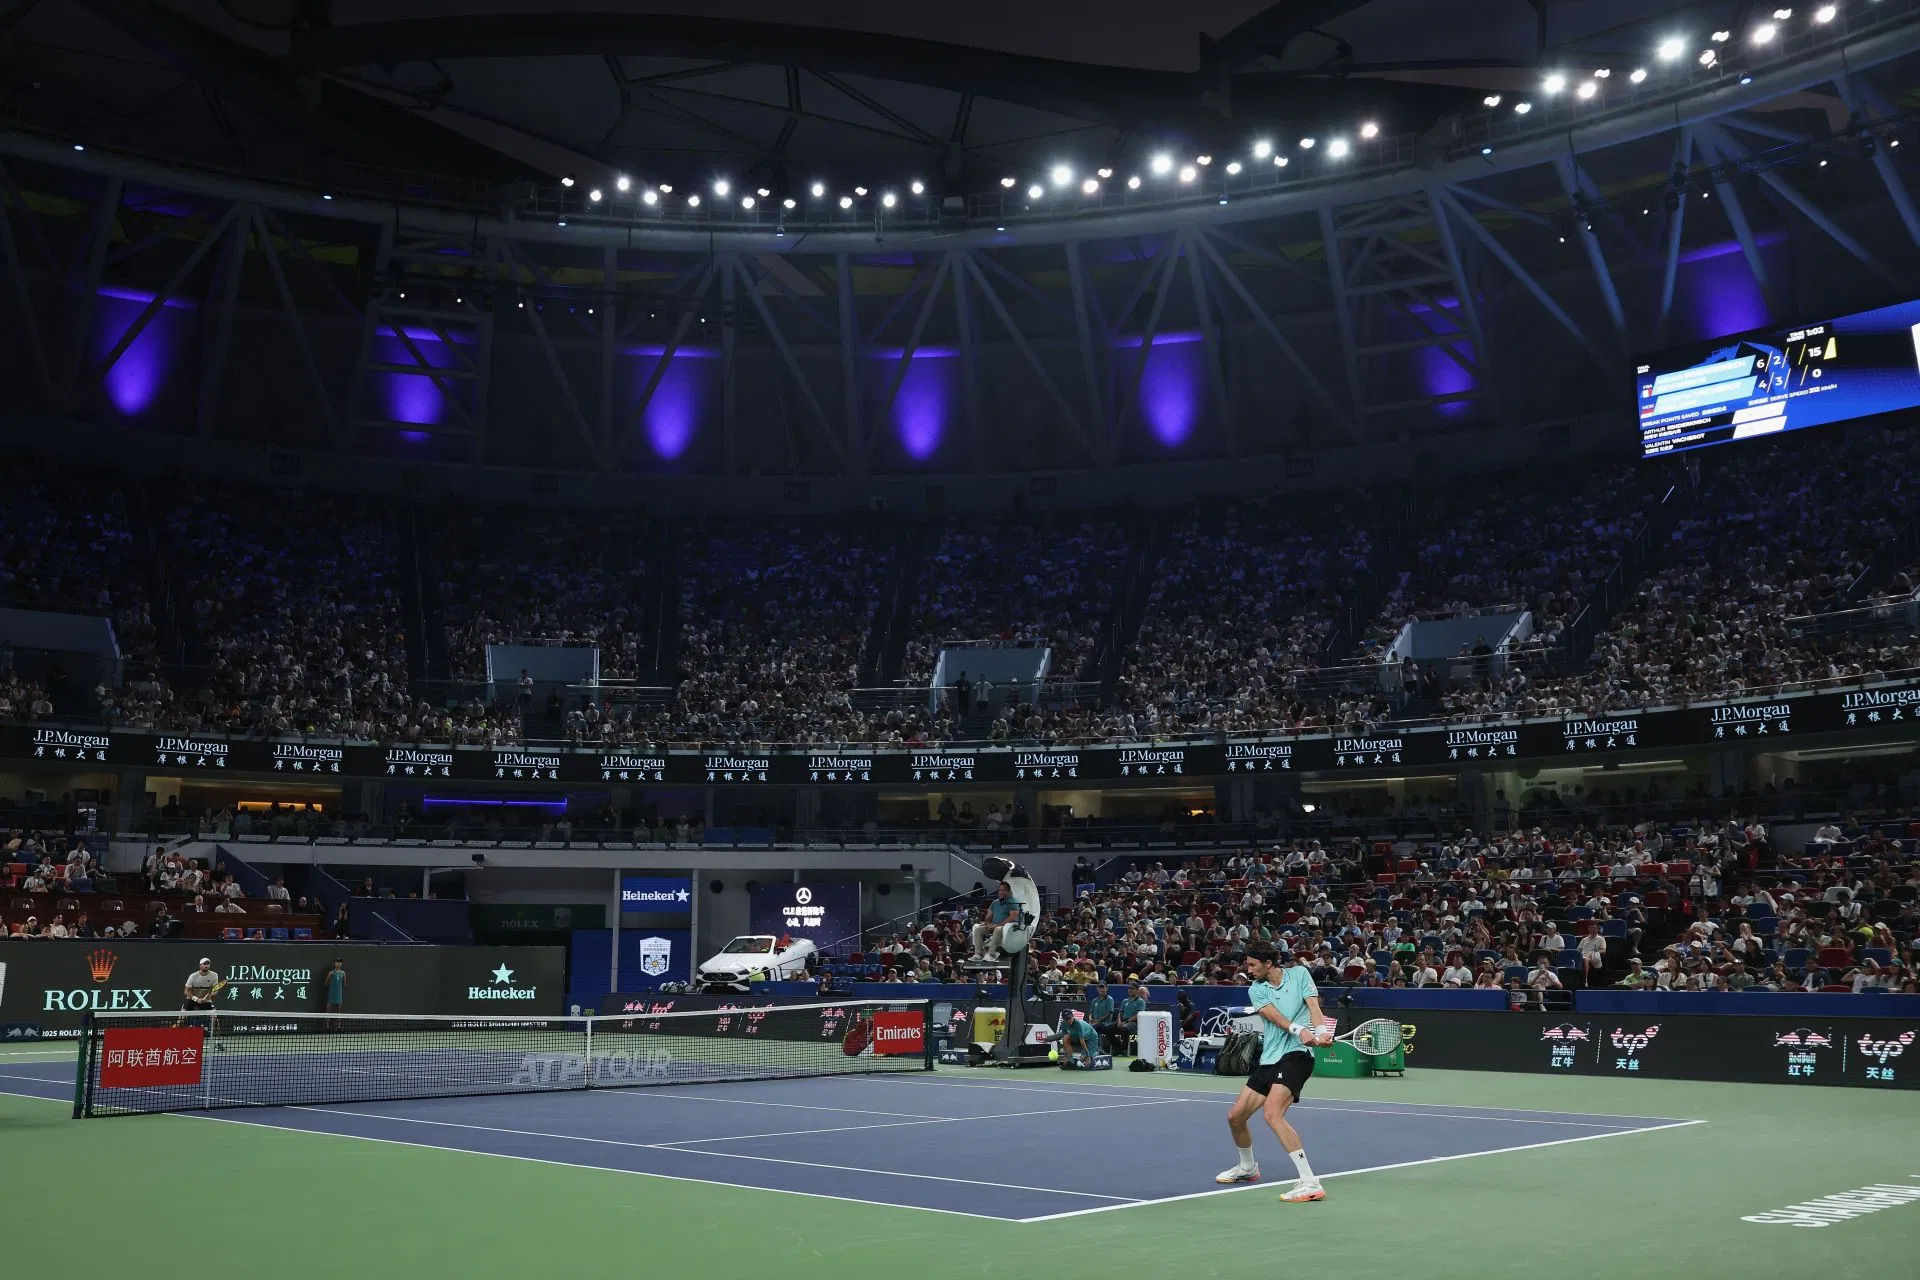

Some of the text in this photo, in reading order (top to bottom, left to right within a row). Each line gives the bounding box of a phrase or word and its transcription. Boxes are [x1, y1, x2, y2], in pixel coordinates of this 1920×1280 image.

[1806, 326, 1824, 336] 1:02
[1756, 347, 1822, 368] 6 2 15
[1758, 368, 1822, 388] 4 3 0
[1645, 439, 1671, 449] VALENTIN
[1842, 688, 1920, 708] J.P.Morga
[1714, 720, 1790, 738] 摩根大通
[1566, 735, 1636, 750] 摩根大通
[34, 746, 107, 760] 摩根大通
[1449, 745, 1516, 759] 摩根大通
[157, 754, 226, 766] 摩根大通
[1228, 759, 1291, 771] 摩根大通
[1337, 753, 1401, 765] 摩根大通
[274, 760, 340, 772] 摩根大通
[387, 765, 450, 776] 摩根大通
[1121, 764, 1182, 775] 摩根大通
[496, 768, 558, 779] 摩根大通
[602, 771, 663, 780] 摩根大通
[707, 772, 767, 781] 摩根大通
[810, 772, 870, 781] 摩根大通
[913, 770, 972, 780] 摩根大通
[1017, 768, 1077, 778] 摩根大通
[622, 890, 675, 900] Heineken
[226, 965, 311, 985] J.P.Morgan
[227, 986, 307, 1000] 摩根大通
[468, 986, 536, 999] Heineken
[43, 989, 152, 1011] ROLEX
[59, 1029, 81, 1037] ROLEX
[876, 1026, 921, 1041] Emirates
[107, 1047, 197, 1068] 阿联酋航空
[1551, 1056, 1574, 1067] 红牛
[511, 1049, 673, 1087] ATP TOUR
[1615, 1058, 1640, 1070] 天丝
[1788, 1064, 1815, 1076] 红牛
[1866, 1066, 1895, 1080] 天丝
